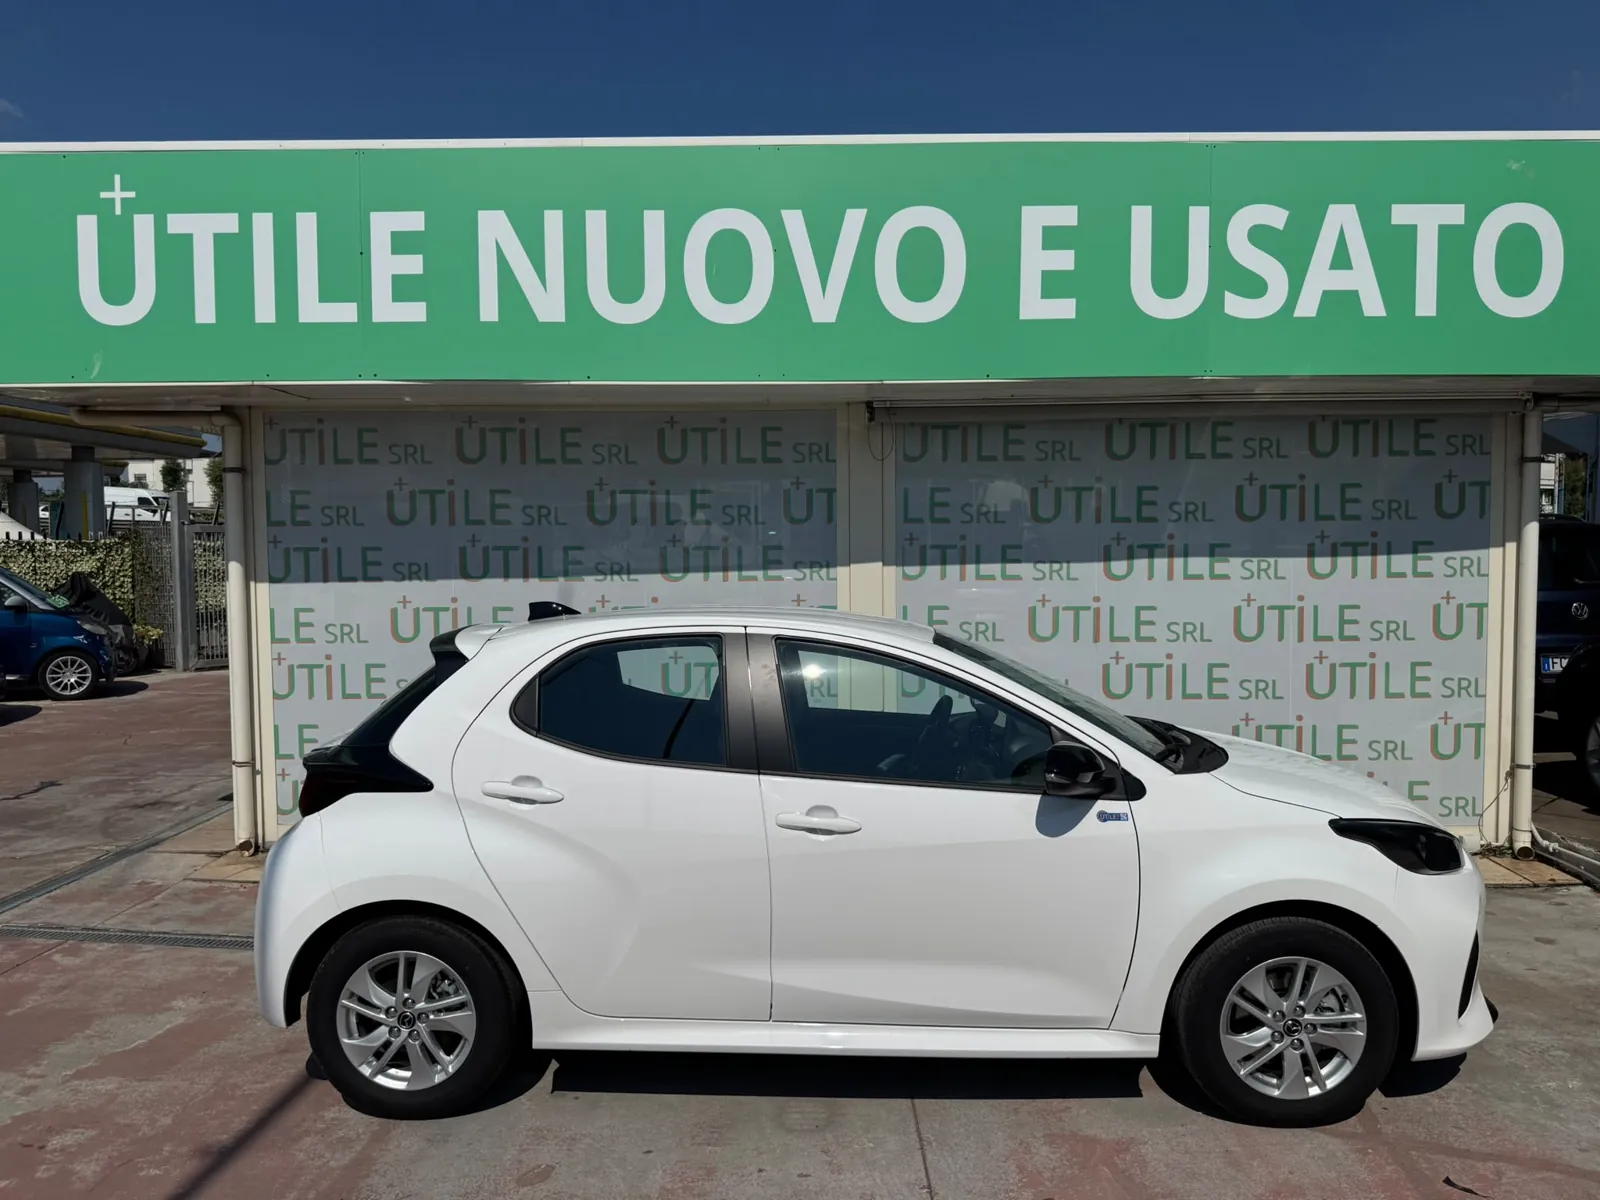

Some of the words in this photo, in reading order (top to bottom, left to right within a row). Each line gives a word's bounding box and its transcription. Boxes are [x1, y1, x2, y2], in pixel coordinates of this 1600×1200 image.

[76, 174, 427, 326] UTILE
[477, 205, 967, 326] NUOVO
[1018, 205, 1078, 320] E
[1130, 202, 1565, 320] USATO
[388, 444, 432, 465] SRL
[592, 444, 637, 465] SRL
[792, 442, 836, 463] SRL
[1034, 440, 1081, 462] SRL
[1242, 437, 1288, 459] SRL
[1445, 434, 1491, 456] SRL
[320, 506, 365, 527] SRL
[522, 505, 566, 526] SRL
[722, 505, 765, 525] SRL
[903, 487, 950, 524] LE
[960, 503, 1006, 524] SRL
[1168, 502, 1214, 522] SRL
[1371, 499, 1417, 520] SRL
[393, 562, 433, 582] SRL
[594, 562, 639, 582] SRL
[793, 561, 836, 581] SRL
[1032, 561, 1079, 581] SRL
[1240, 559, 1286, 580] SRL
[1443, 556, 1489, 578] SRL
[324, 624, 369, 644] SRL
[959, 622, 1004, 642] SRL
[1166, 622, 1212, 643] SRL
[1370, 621, 1415, 641] SRL
[1238, 679, 1284, 700] SRL
[1440, 678, 1486, 698] SRL
[1367, 740, 1413, 760] SRL
[1438, 796, 1483, 817] SRL
